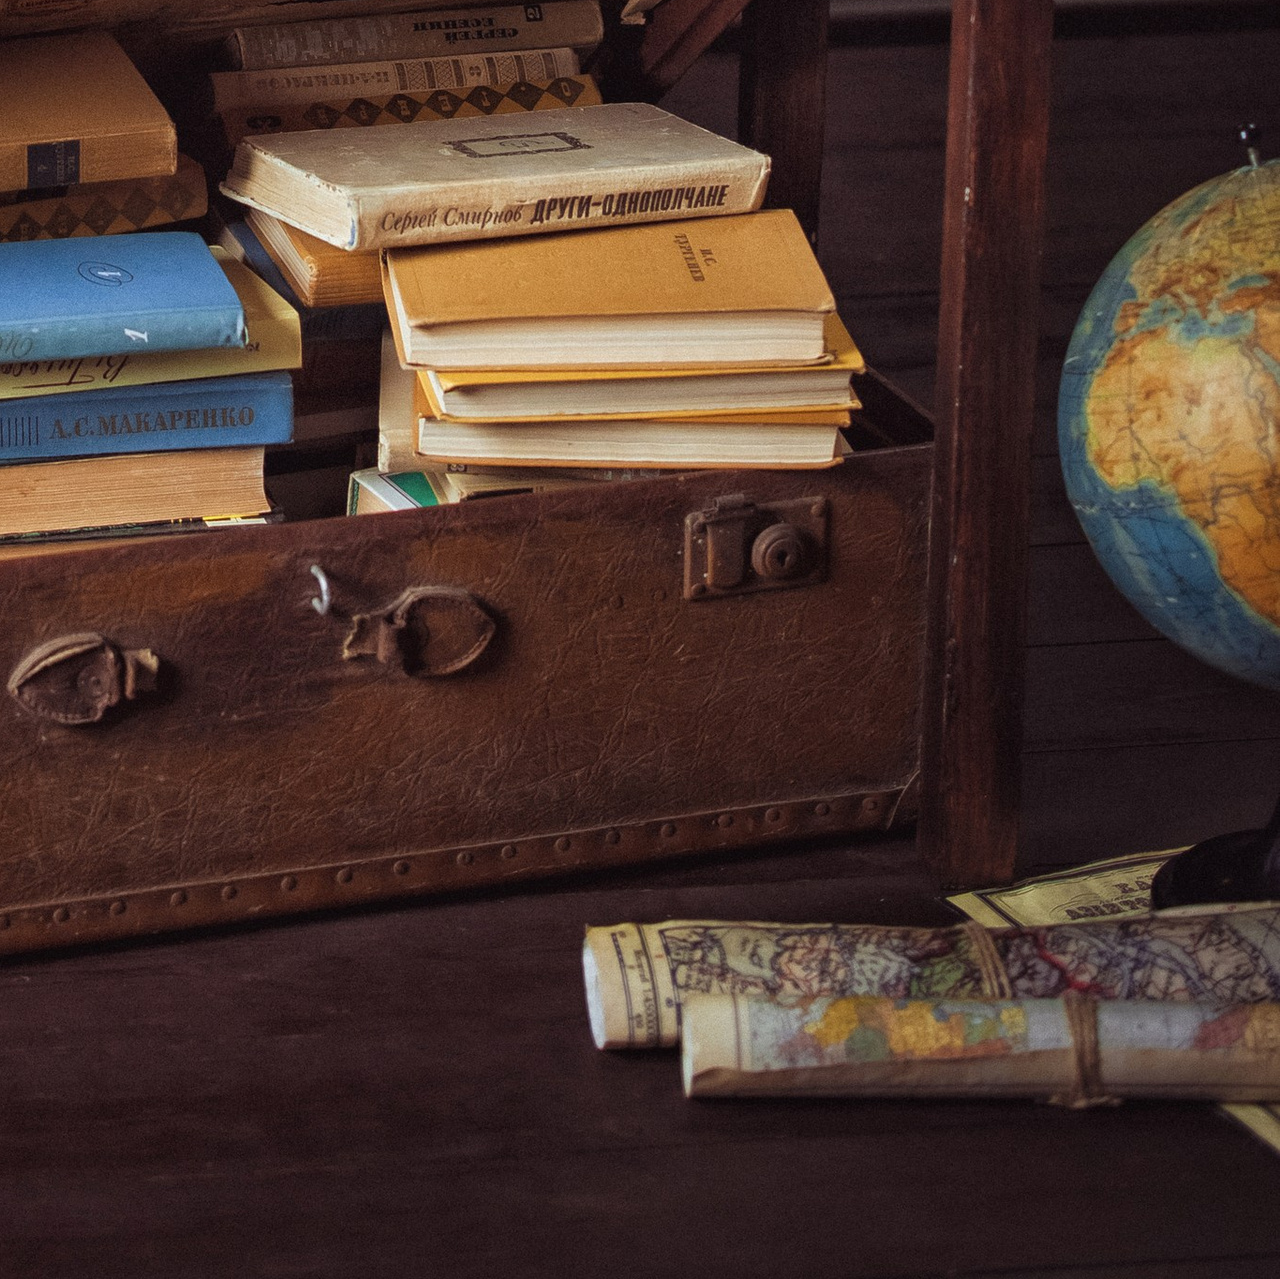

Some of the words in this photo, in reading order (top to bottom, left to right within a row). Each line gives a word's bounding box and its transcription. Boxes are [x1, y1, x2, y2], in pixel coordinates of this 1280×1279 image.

[413, 17, 496, 33] ЕСЕНИН
[445, 27, 519, 45] СЕРГЕЙ
[380, 210, 438, 237] Сергей
[443, 202, 524, 230] Смирнов
[530, 184, 730, 225] ДРУГИ-ОДНОПОЛЧАНЕ
[674, 232, 706, 284] ТУРГЕНЕВ
